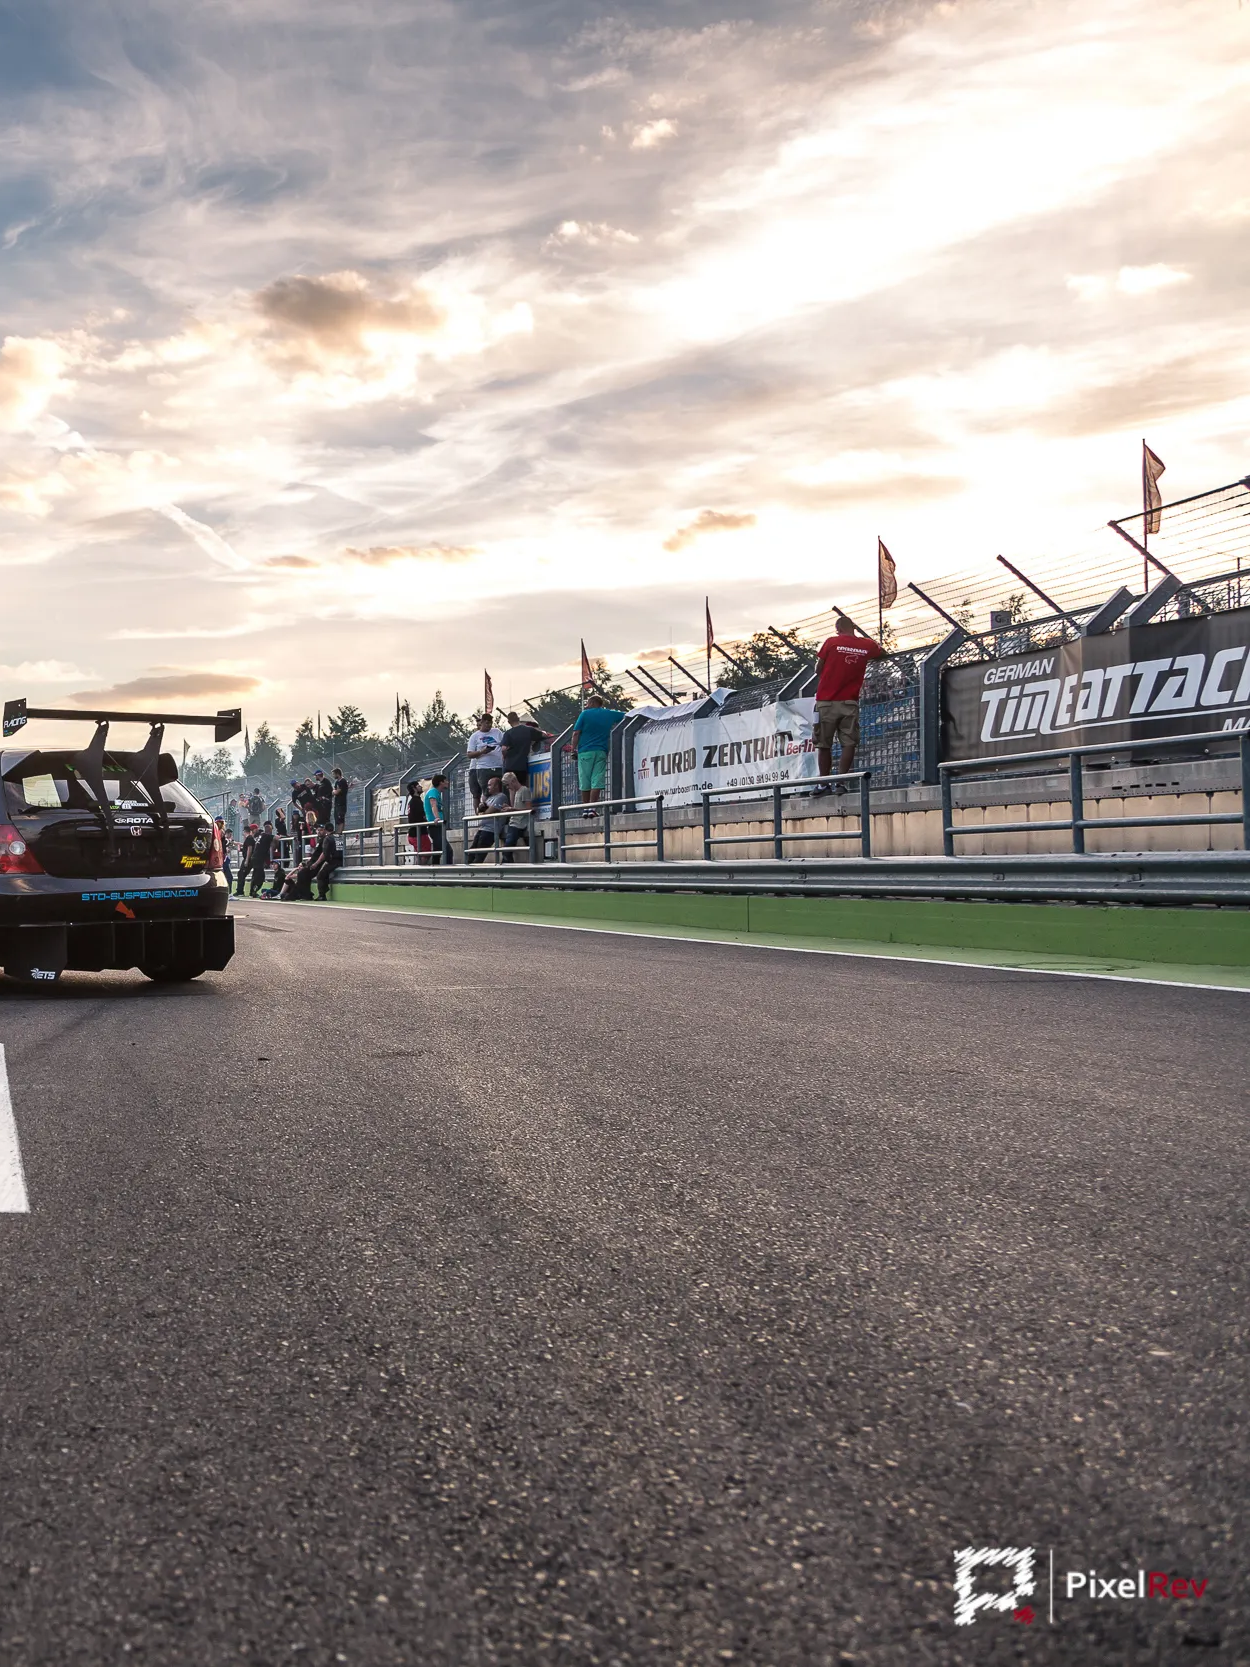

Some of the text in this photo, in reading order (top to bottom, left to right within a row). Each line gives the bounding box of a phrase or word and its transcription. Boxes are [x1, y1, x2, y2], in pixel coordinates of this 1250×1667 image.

[983, 657, 1054, 685] GERMAN
[3, 716, 27, 729] RACING
[650, 747, 697, 777] TURBO
[780, 769, 790, 781] 94
[37, 970, 56, 980] ETS
